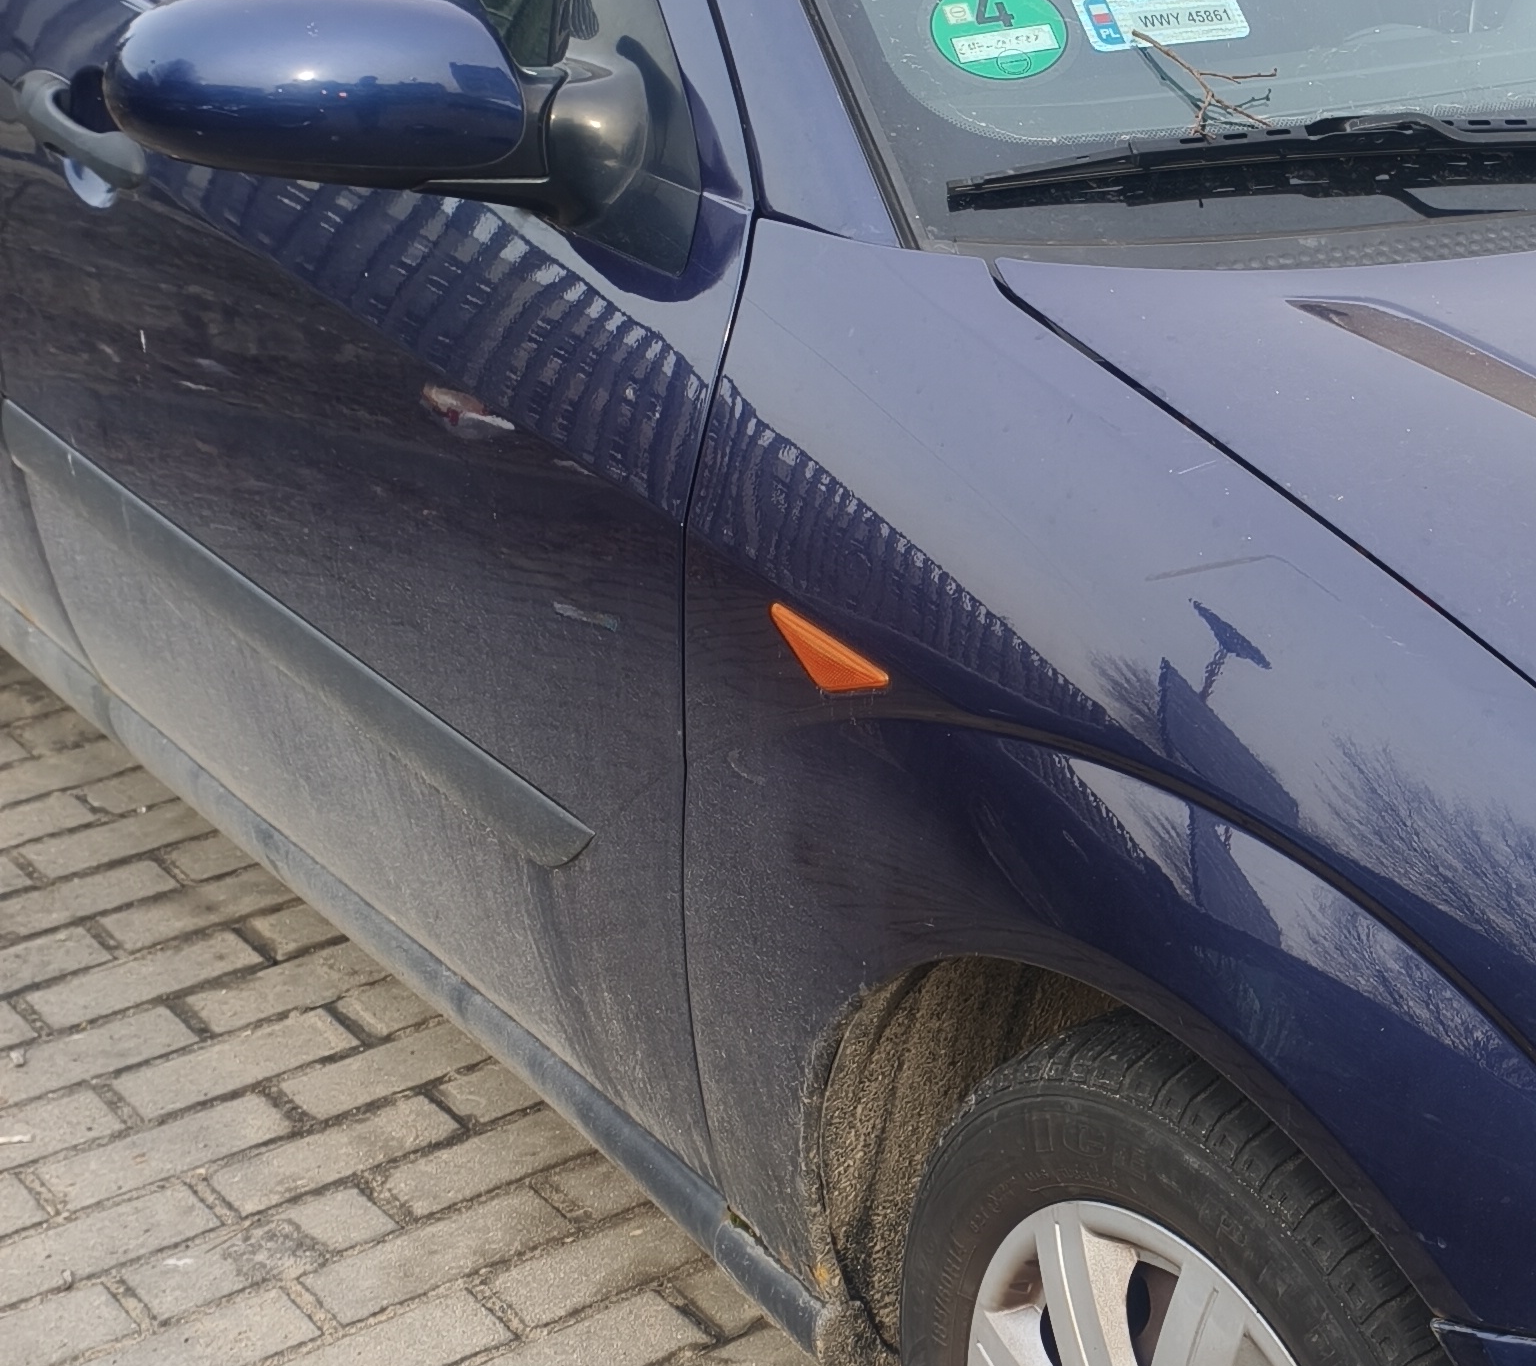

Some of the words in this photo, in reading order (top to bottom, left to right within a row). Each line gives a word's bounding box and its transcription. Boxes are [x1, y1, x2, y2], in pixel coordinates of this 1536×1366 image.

[1138, 11, 1181, 29] WWY
[1187, 7, 1232, 24] 45861
[1101, 28, 1121, 40] PL
